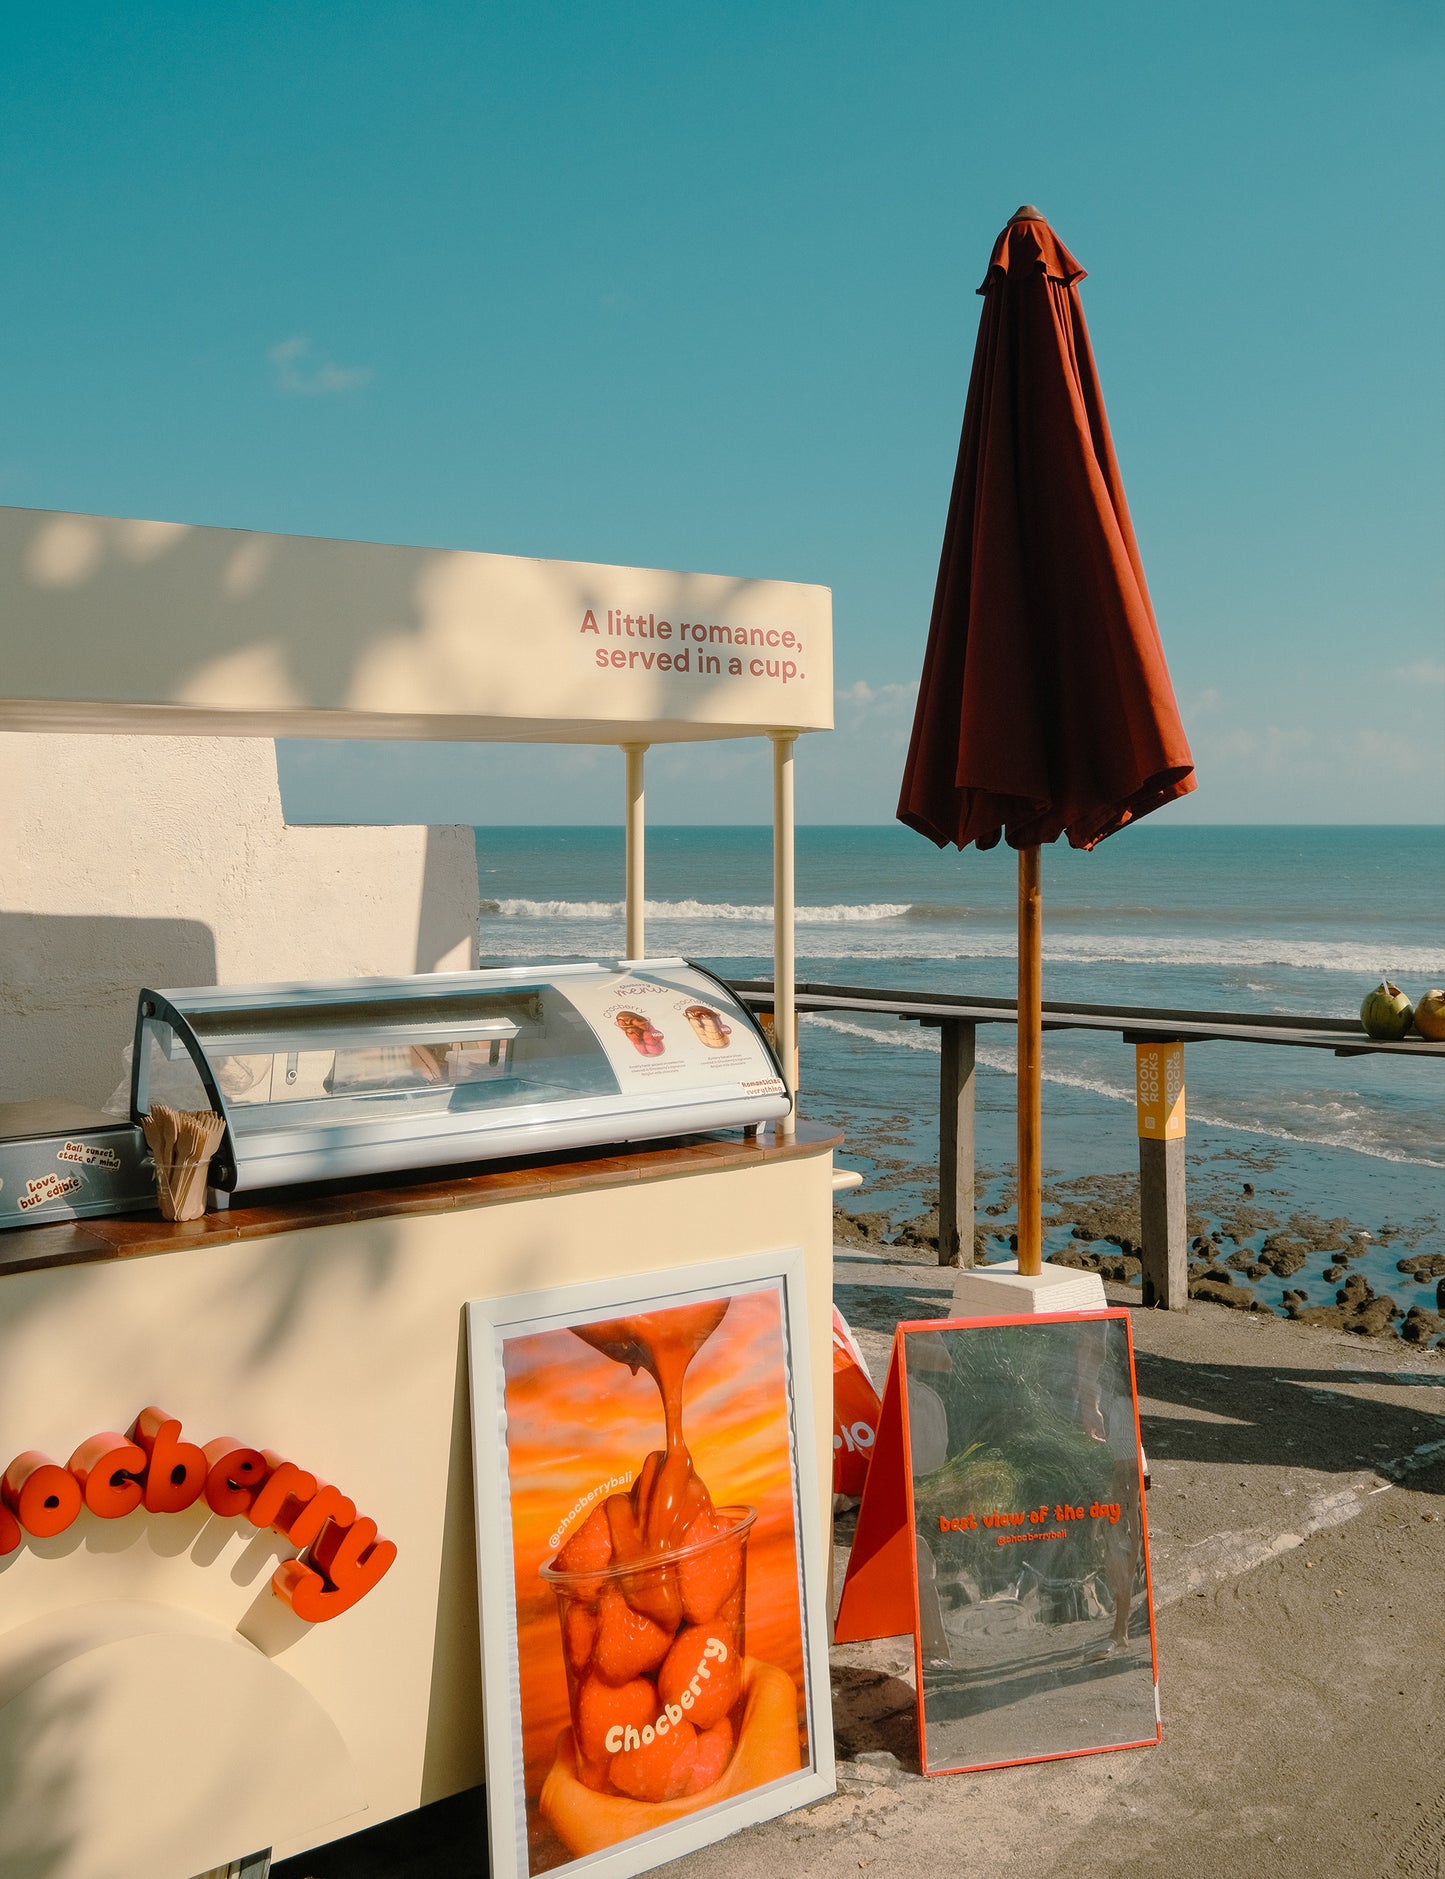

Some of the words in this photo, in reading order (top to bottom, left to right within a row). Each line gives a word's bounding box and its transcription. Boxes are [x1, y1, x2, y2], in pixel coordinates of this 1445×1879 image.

[580, 609, 600, 634] A
[607, 609, 672, 640] little
[680, 620, 803, 653] romance,
[595, 647, 690, 673] served
[697, 647, 721, 674] in
[728, 657, 742, 676] a
[749, 658, 806, 684] cup.
[1140, 1057, 1150, 1106] MOON
[1149, 1052, 1159, 1103] ROCKS
[1166, 1059, 1174, 1106] MOON
[58, 1152, 83, 1162] state
[99, 1158, 119, 1168] mind
[65, 1142, 83, 1153] Bali
[85, 1146, 114, 1158] sunset
[20, 1193, 42, 1209] but
[46, 1178, 80, 1198] edible
[28, 1175, 56, 1193] Love
[0, 1407, 398, 1623] ocberry
[549, 1470, 633, 1548] @chocberrybali
[939, 1513, 978, 1533] best
[982, 1510, 1025, 1529] view
[1029, 1505, 1049, 1524] of
[1054, 1503, 1085, 1522] the
[1089, 1501, 1121, 1524] day
[604, 1637, 729, 1755] Chocberry
